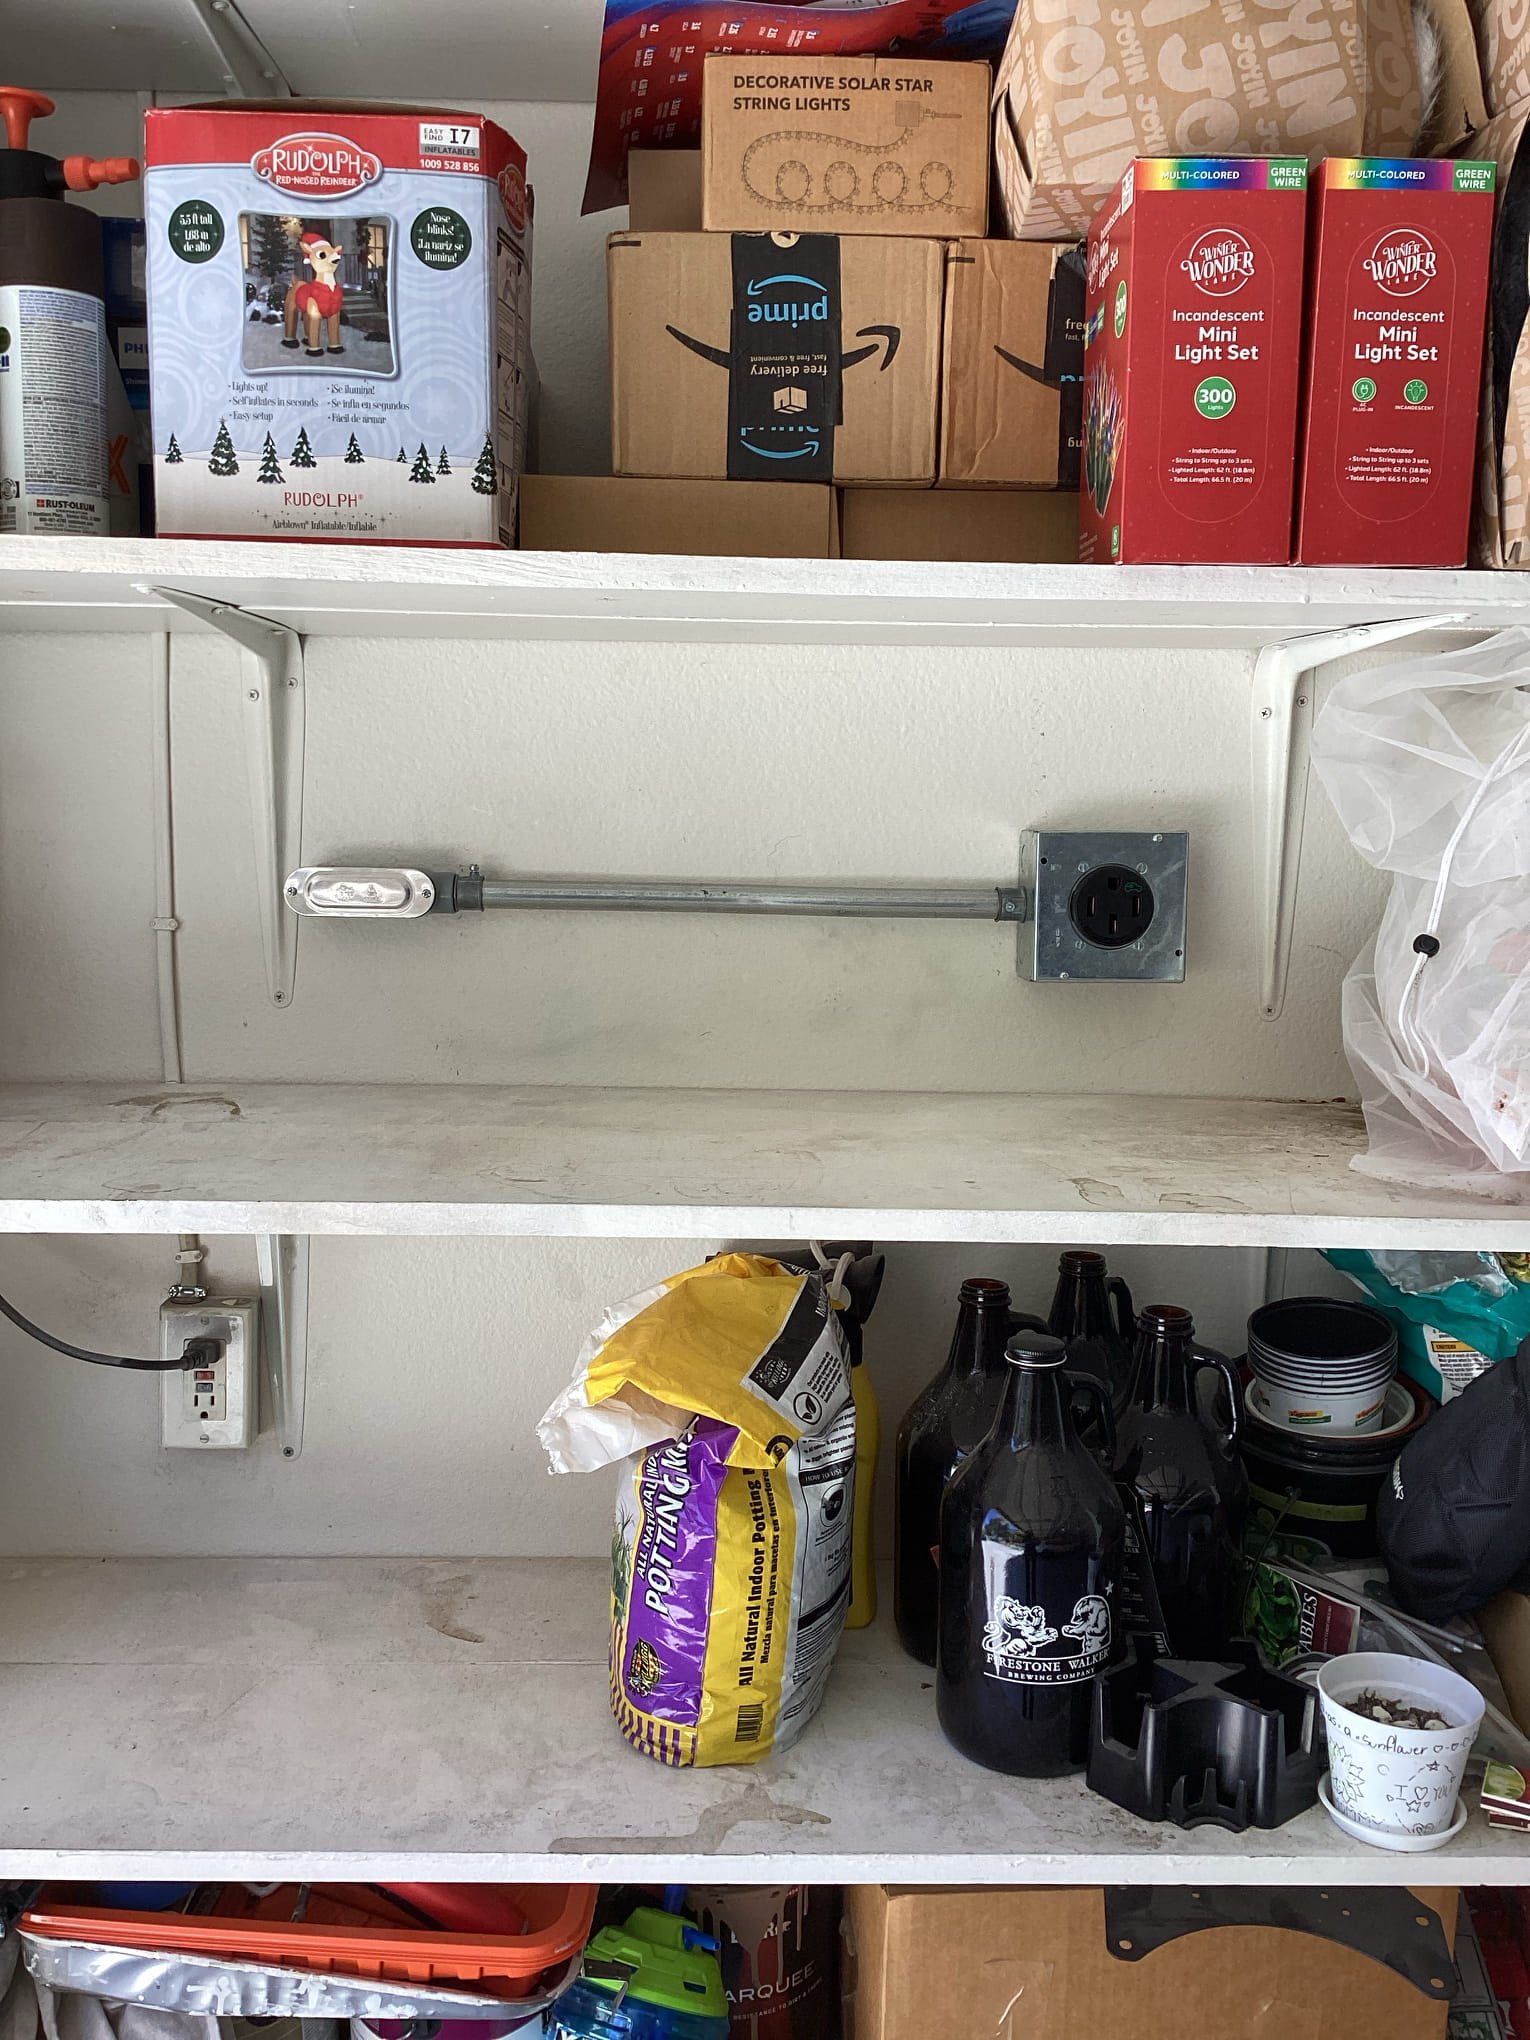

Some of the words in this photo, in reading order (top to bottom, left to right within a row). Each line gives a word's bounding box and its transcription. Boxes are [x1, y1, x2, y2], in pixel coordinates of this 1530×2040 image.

[733, 75, 835, 90] DECORATIVE
[838, 77, 891, 91] SOLAR
[894, 78, 934, 92] STAR
[733, 97, 792, 111] STRING
[795, 98, 851, 112] LIGHTS
[424, 147, 476, 157] INFLATABLES
[272, 149, 361, 174] RUDOLPH
[420, 159, 442, 169] 1009
[444, 160, 461, 170] 528
[462, 162, 479, 172] 856
[1162, 171, 1240, 180] MULTI-COLORED
[1270, 167, 1306, 177] GREEN
[1348, 170, 1426, 180] MULTI-COLORED
[1456, 169, 1491, 179] GREEN
[275, 175, 320, 186] RED-NOSED
[321, 177, 357, 186] REINDEER
[1274, 177, 1302, 187] WIRE
[1459, 179, 1486, 189] WIRE
[200, 213, 213, 225] tall
[430, 212, 451, 223] Nose
[200, 231, 209, 240] m
[427, 223, 454, 236] blinks!
[183, 241, 194, 252] de
[195, 241, 211, 252] alto
[431, 240, 453, 250] nariz
[1180, 251, 1254, 281] WONDER
[1363, 251, 1437, 281] WONDER
[747, 296, 828, 328] prime
[1173, 310, 1265, 322] Incandescent
[1353, 308, 1445, 323] Incandescent
[1199, 326, 1237, 342] Mini
[1379, 326, 1417, 342] Mini
[813, 354, 827, 362] fast,
[1175, 344, 1222, 364] Light
[1228, 344, 1259, 360] Set
[1355, 343, 1402, 363] Light
[1407, 344, 1438, 361] Set
[750, 365, 800, 377] delivery
[803, 365, 827, 377] free
[232, 382, 254, 392] Lights
[256, 382, 268, 393] up!
[278, 397, 285, 406] in
[286, 398, 319, 407] seconds
[1199, 389, 1233, 403] 300
[331, 400, 342, 408] Se
[372, 401, 410, 411] segundos
[233, 411, 251, 421] Easy
[253, 412, 274, 422] setup
[351, 414, 361, 423] de
[362, 416, 386, 424] armar
[1175, 457, 1193, 465] String
[46, 499, 95, 512] RUST-OLEUM
[747, 1479, 766, 1543] Potting
[636, 1551, 648, 1580] ALL
[642, 1480, 658, 1548] NATURAL
[772, 1519, 780, 1532] en
[645, 1474, 690, 1617] POTTING
[770, 1534, 780, 1573] macetas
[747, 1547, 766, 1602] Indoor
[768, 1574, 778, 1596] para
[764, 1598, 775, 1631] natural
[741, 1604, 761, 1662] Natural
[760, 1633, 772, 1664] Mezcla
[1068, 1648, 1109, 1670] WALKER
[738, 1666, 754, 1686] All
[1008, 1671, 1052, 1681] BREWING
[1056, 1668, 1095, 1681] COMPANY
[1394, 1784, 1408, 1801] I
[725, 1960, 816, 2003] ARQUEE
